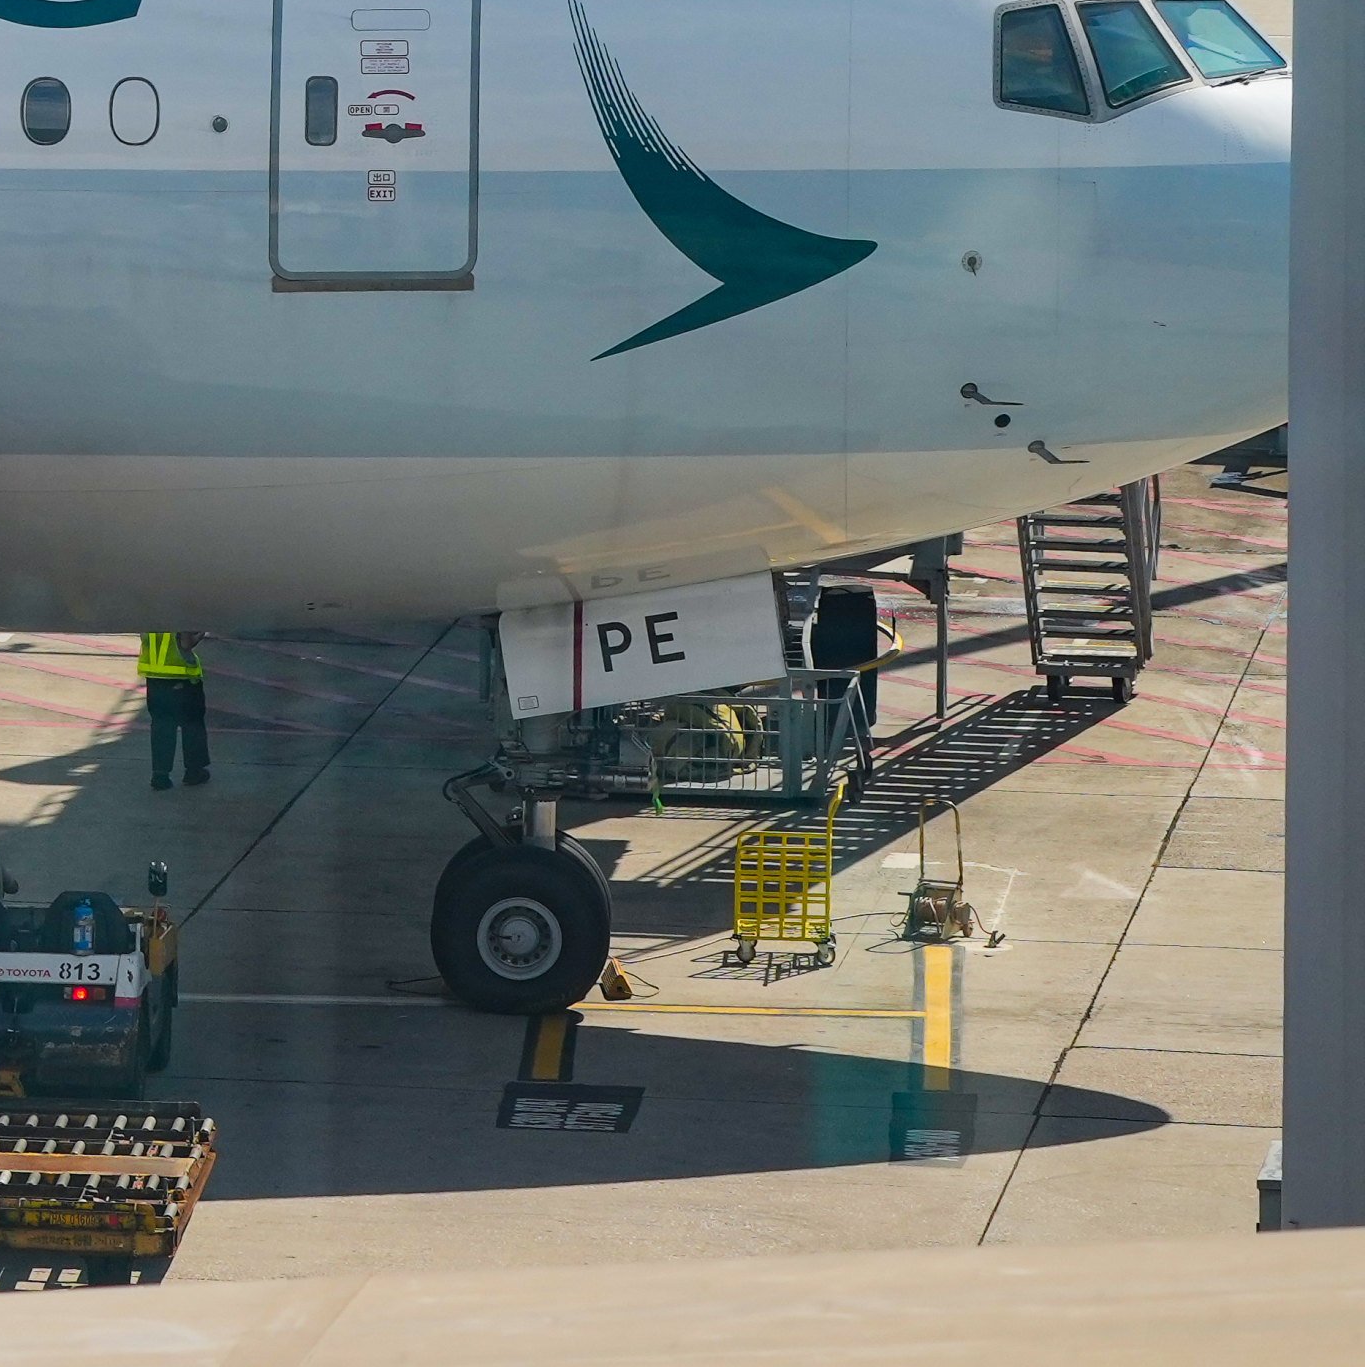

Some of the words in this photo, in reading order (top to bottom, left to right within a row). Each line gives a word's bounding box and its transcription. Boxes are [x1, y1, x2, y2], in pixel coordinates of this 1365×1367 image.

[349, 106, 371, 114] OPEN
[372, 173, 391, 182] 出口
[369, 189, 394, 198] EXIT
[596, 611, 686, 673] PE
[7, 968, 52, 978] TOYOTA
[58, 962, 101, 981] 813
